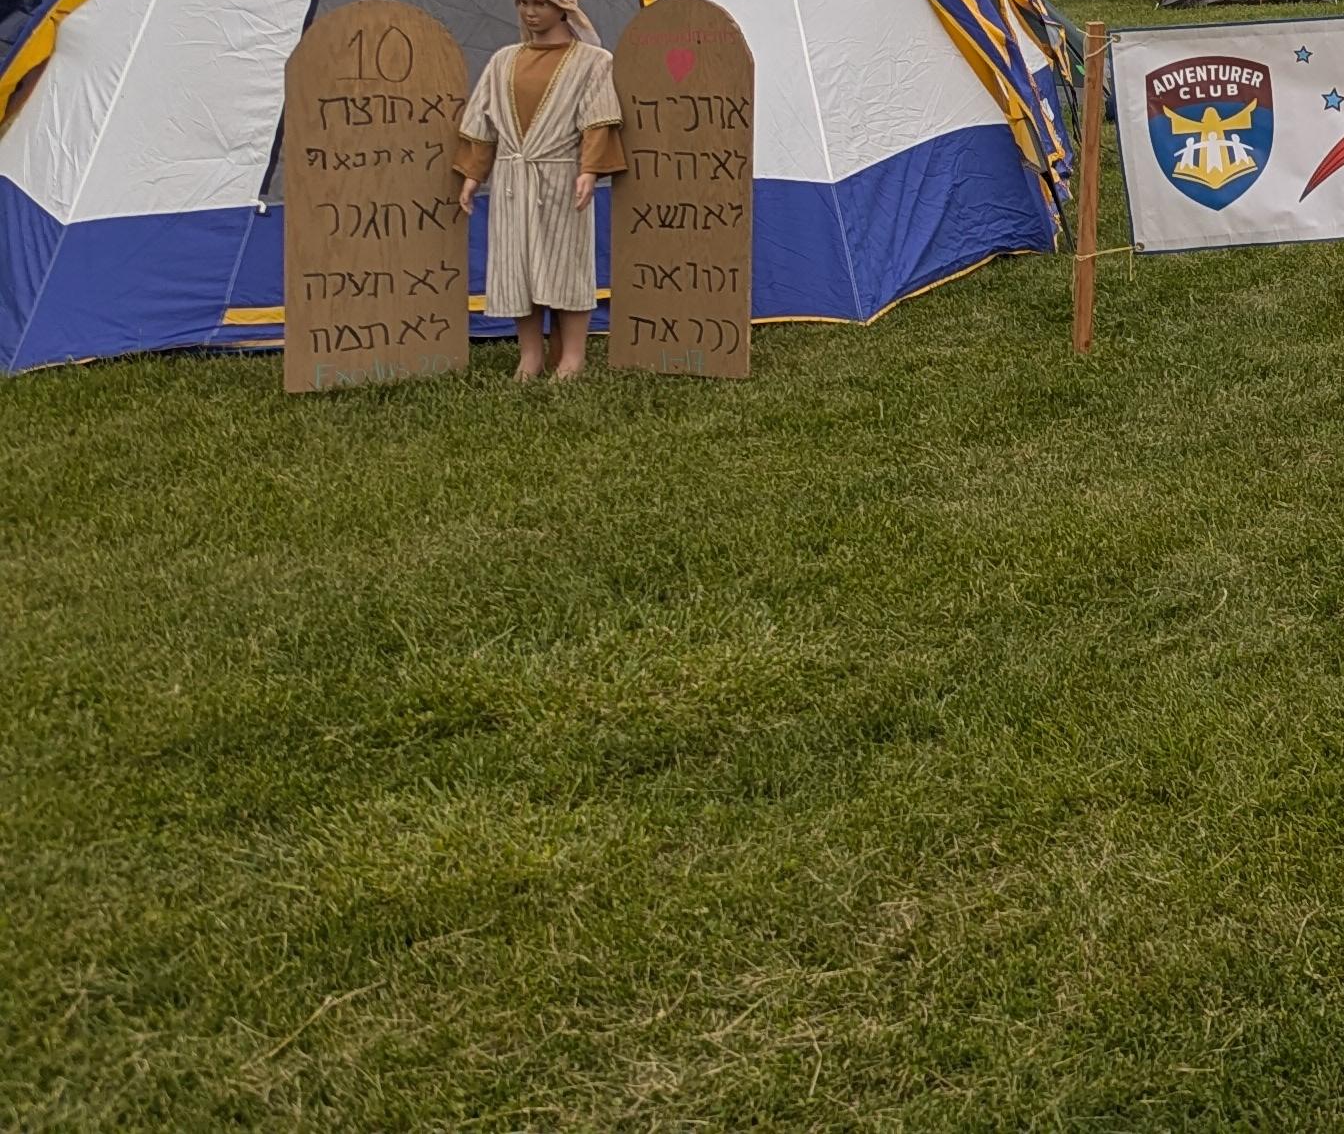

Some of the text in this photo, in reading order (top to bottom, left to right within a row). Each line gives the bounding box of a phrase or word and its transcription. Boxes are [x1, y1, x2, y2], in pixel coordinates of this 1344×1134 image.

[336, 25, 414, 83] 10
[1152, 64, 1264, 96] ADVENTURER
[1179, 83, 1239, 100] CLUB
